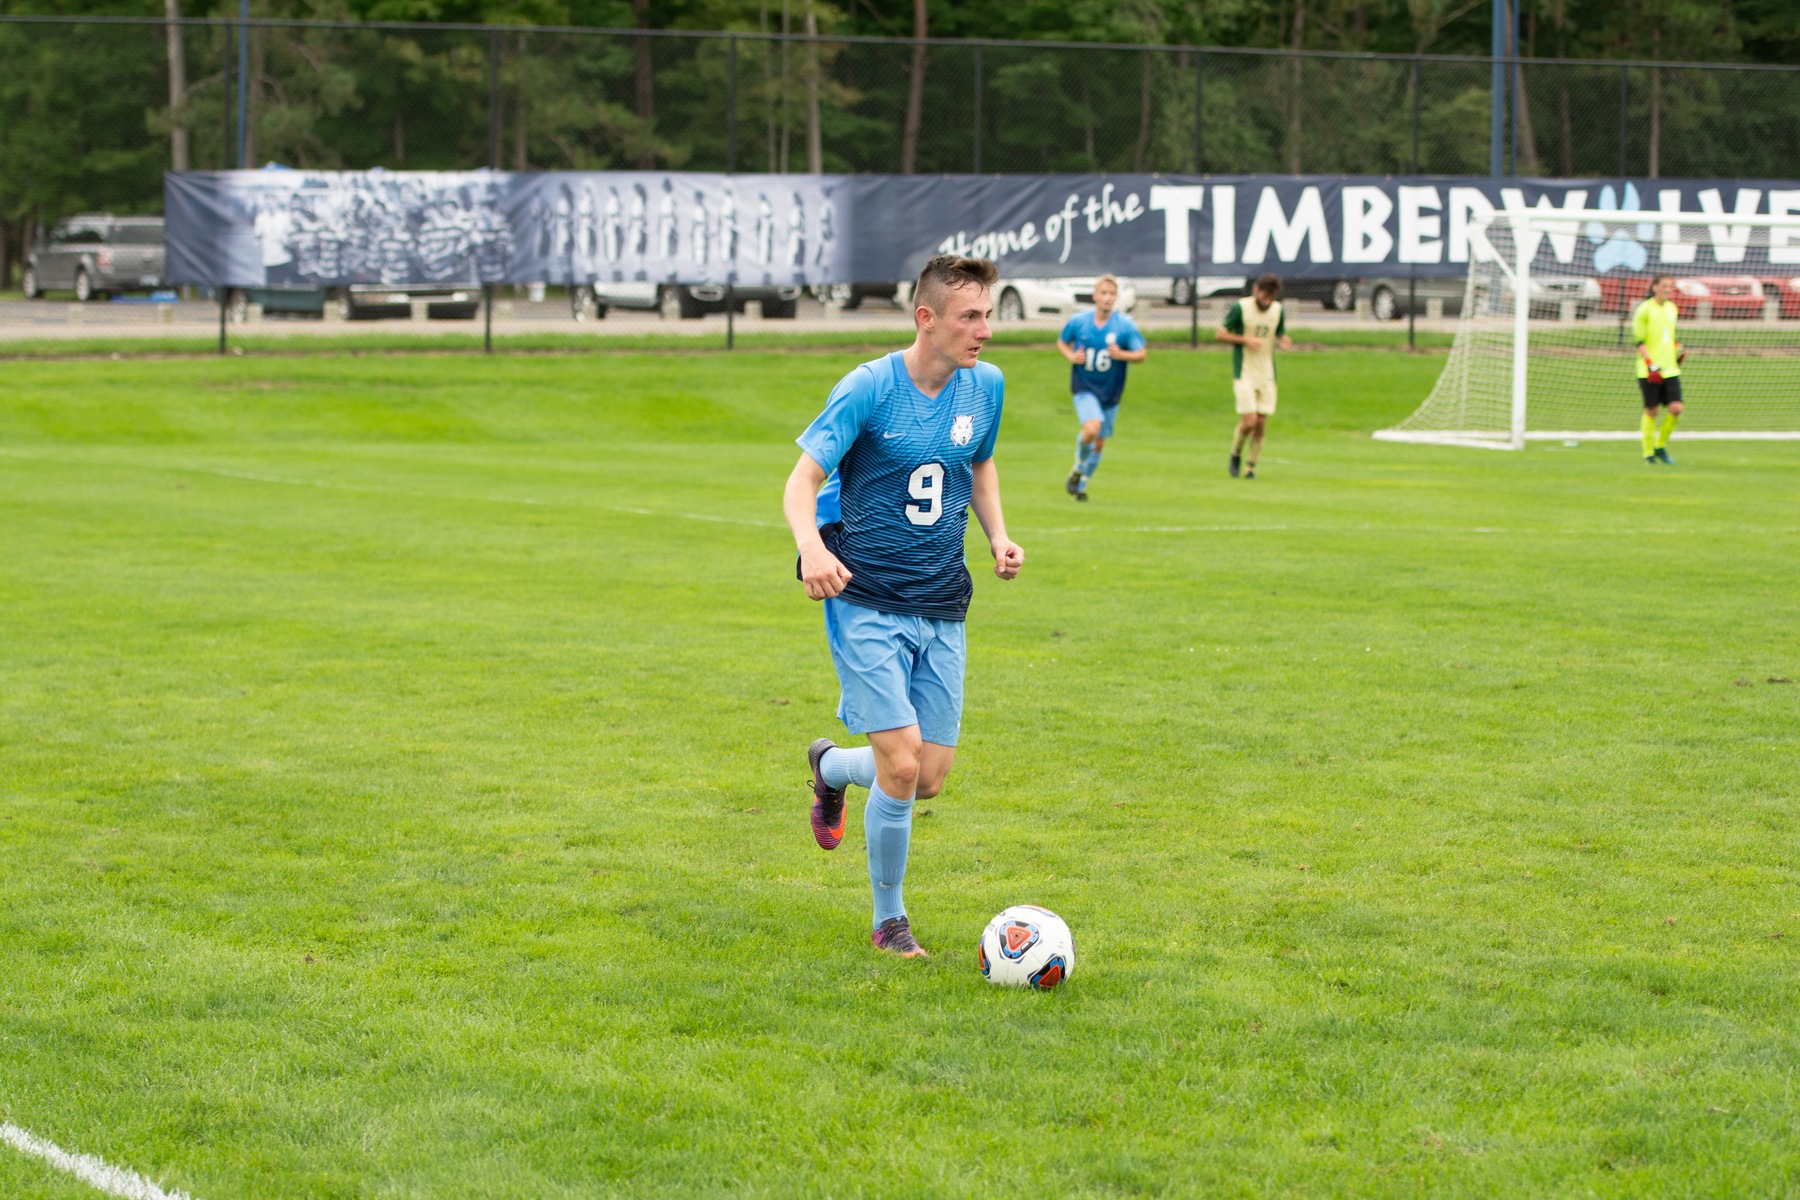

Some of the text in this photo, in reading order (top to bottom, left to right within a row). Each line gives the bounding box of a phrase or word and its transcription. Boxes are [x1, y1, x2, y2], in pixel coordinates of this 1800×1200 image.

[938, 221, 1041, 263] Home
[1044, 193, 1080, 264] of
[1081, 182, 1145, 233] the
[1085, 347, 1112, 372] 16
[905, 463, 945, 526] 9
